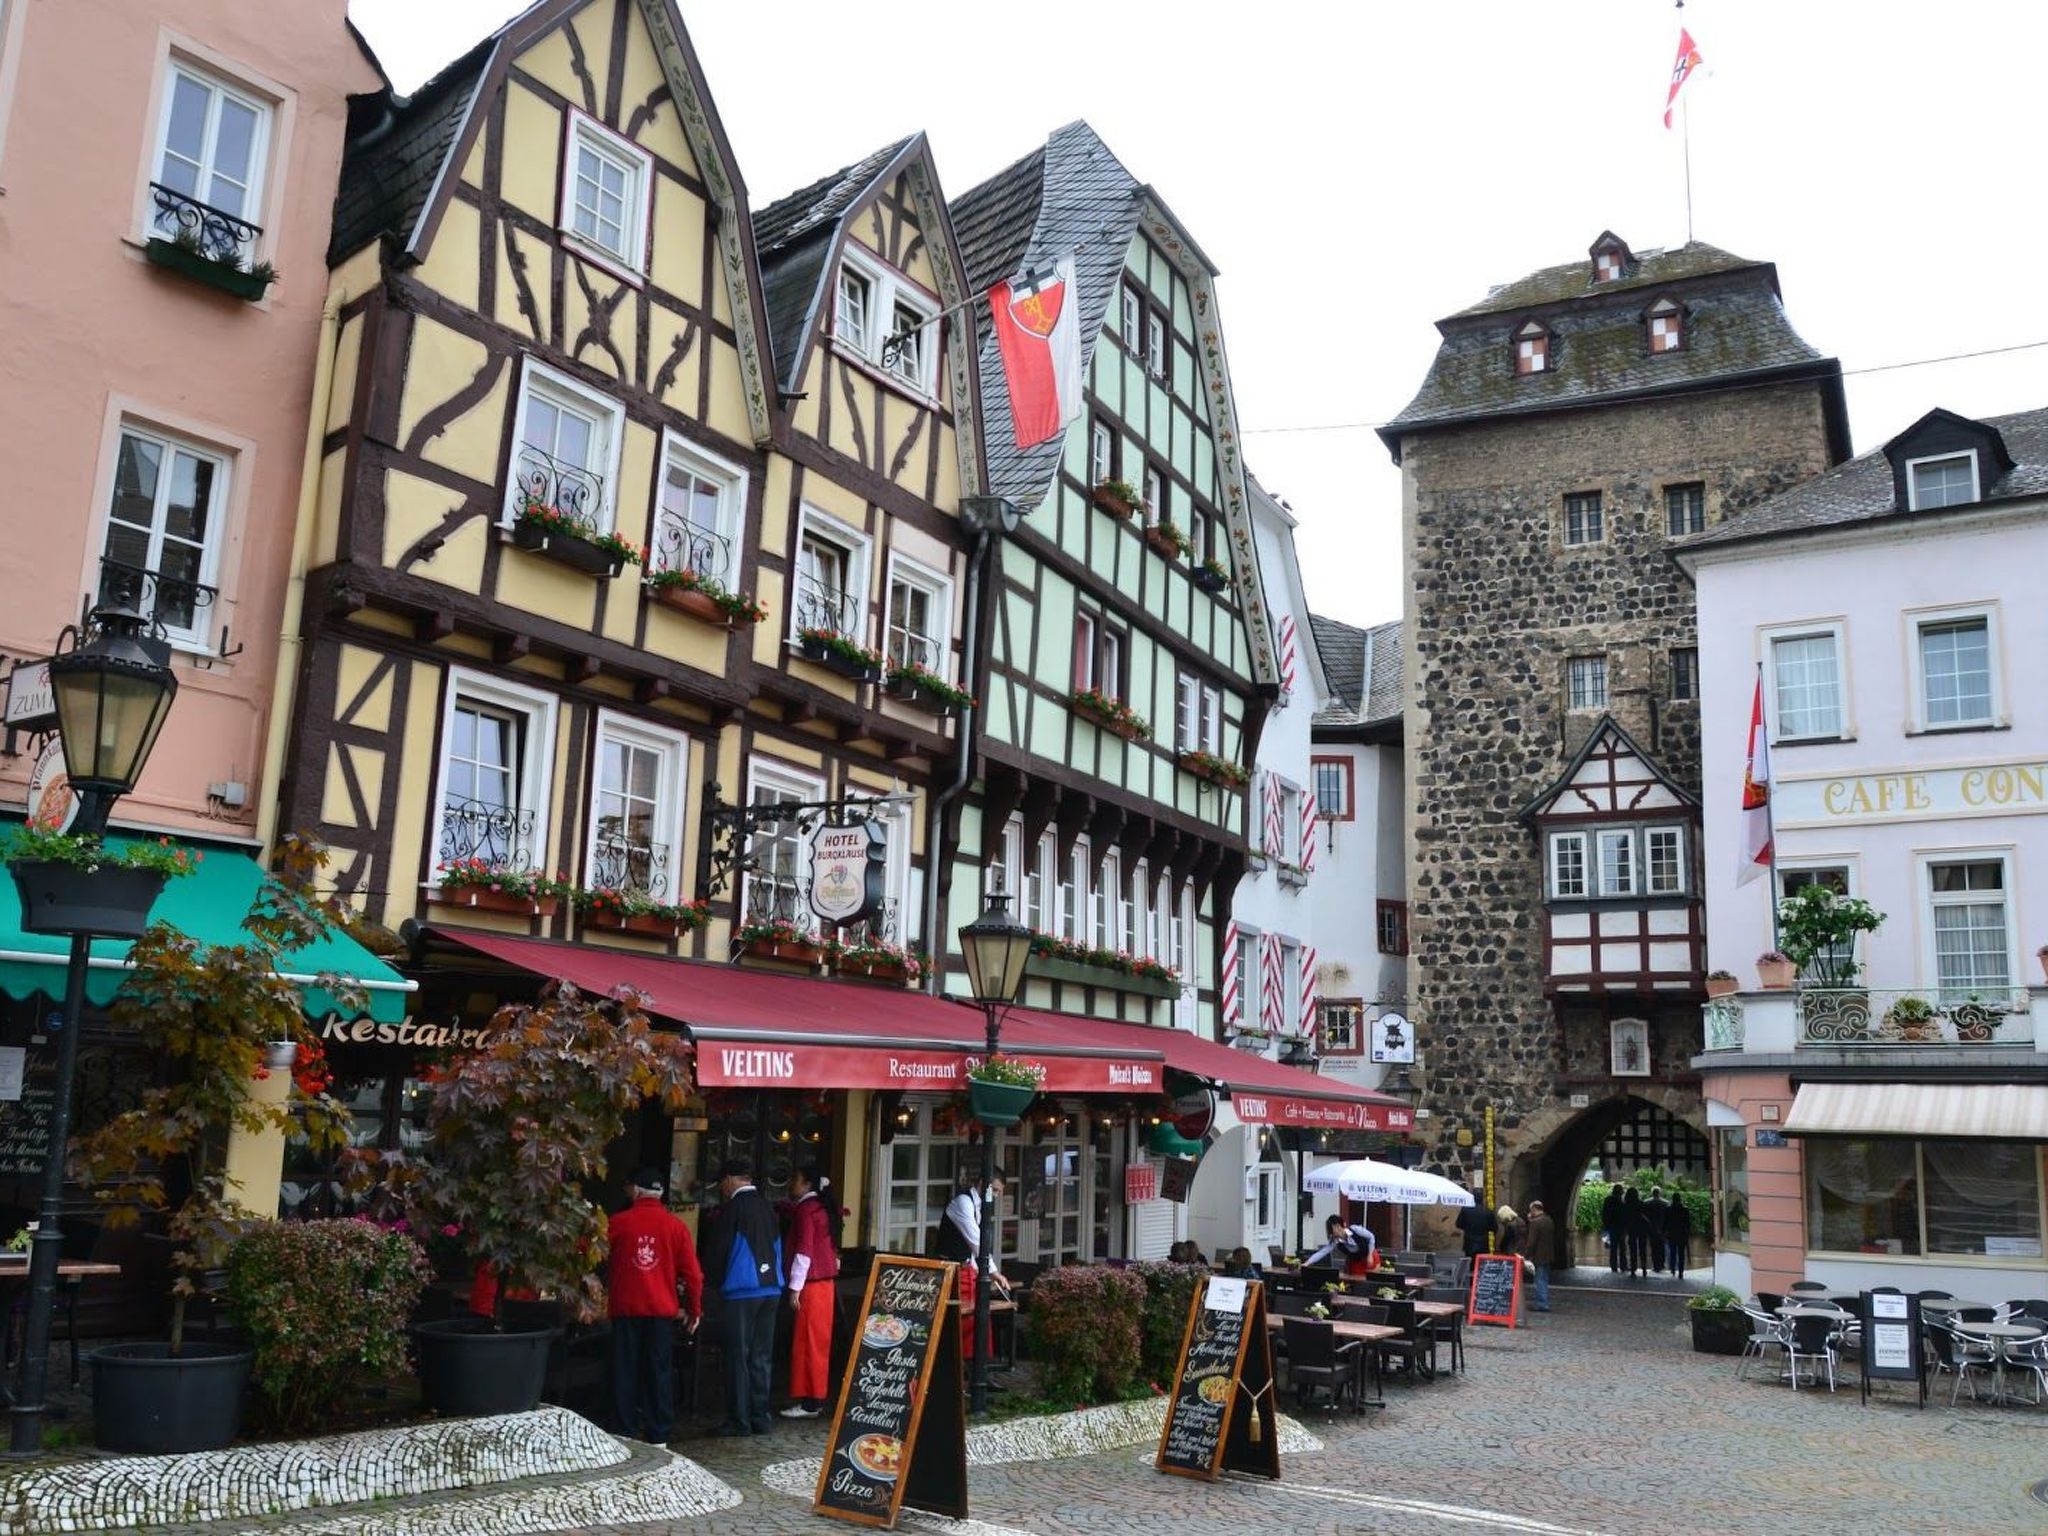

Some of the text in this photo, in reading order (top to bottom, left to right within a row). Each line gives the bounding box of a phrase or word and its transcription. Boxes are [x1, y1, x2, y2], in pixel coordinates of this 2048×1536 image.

[1823, 771, 1931, 816] CAFE
[824, 834, 859, 847] HOTEL
[721, 1049, 794, 1078] VELTINS
[889, 1058, 956, 1079] Restaurant
[1239, 1098, 1267, 1117] VELTINS
[1357, 1184, 1388, 1195] VELTINS
[885, 1347, 917, 1368] Pasta
[860, 1358, 908, 1383] Spaghetti
[832, 1467, 874, 1499] Pizza
